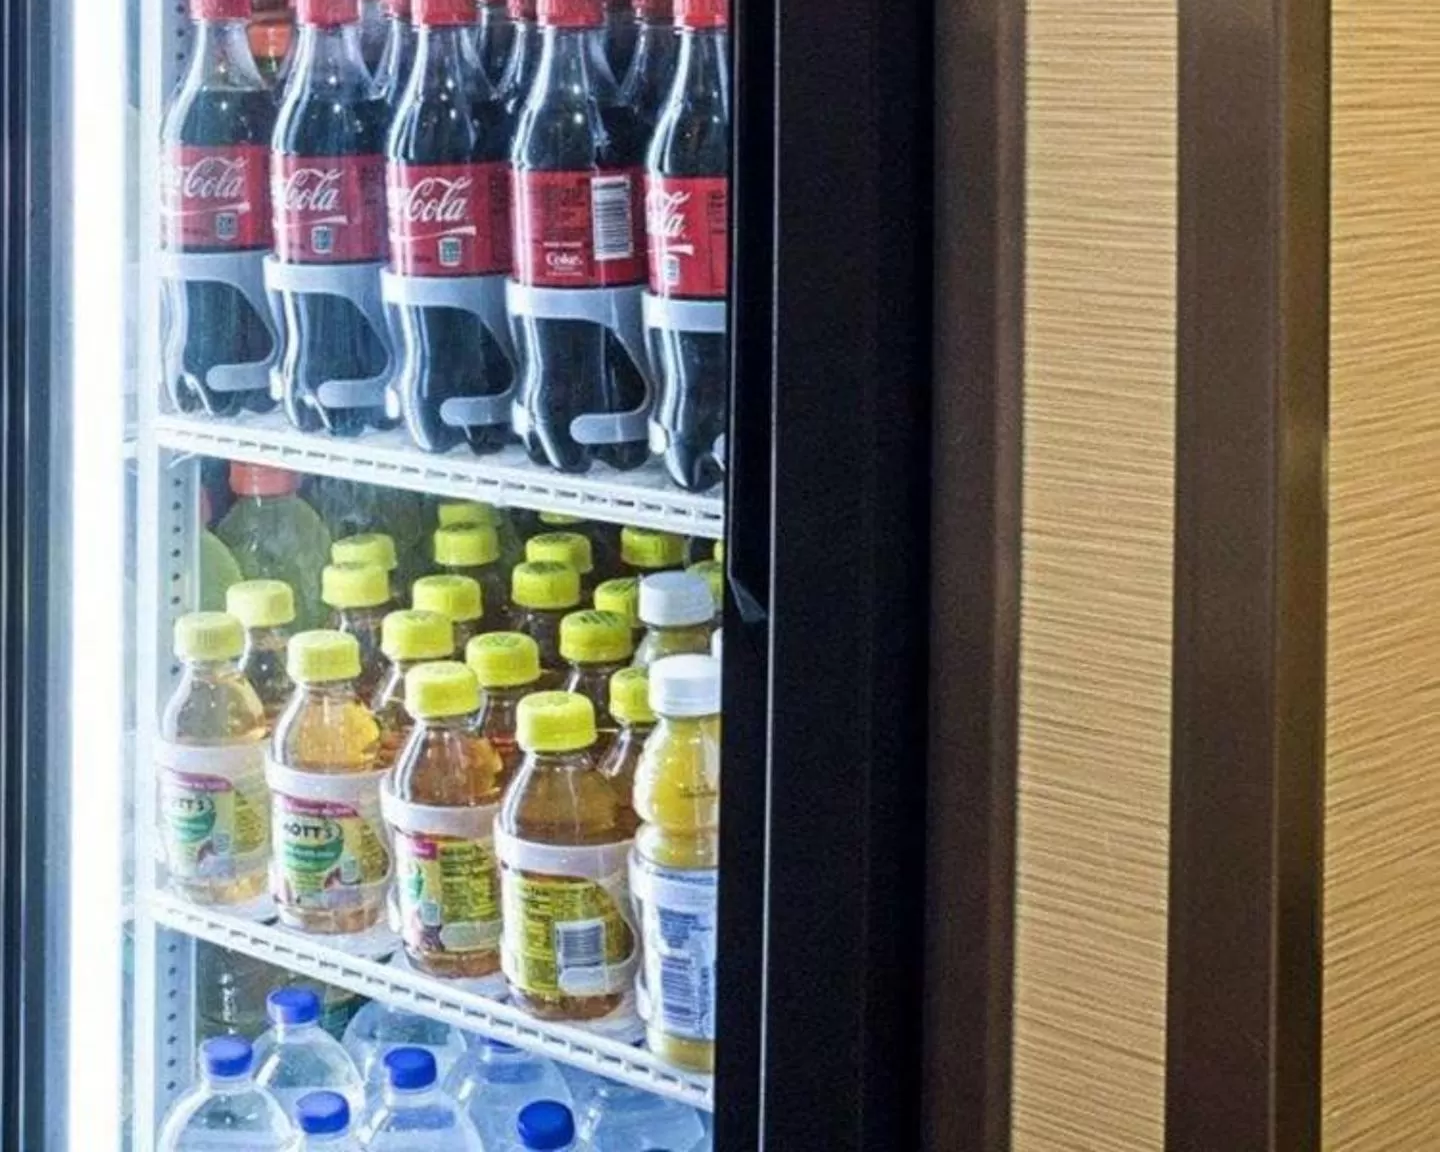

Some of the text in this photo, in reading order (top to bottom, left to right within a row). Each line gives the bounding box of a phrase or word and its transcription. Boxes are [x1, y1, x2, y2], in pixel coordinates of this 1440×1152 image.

[184, 156, 249, 198] Cola
[284, 168, 344, 211] Cola
[408, 176, 474, 222] Cola
